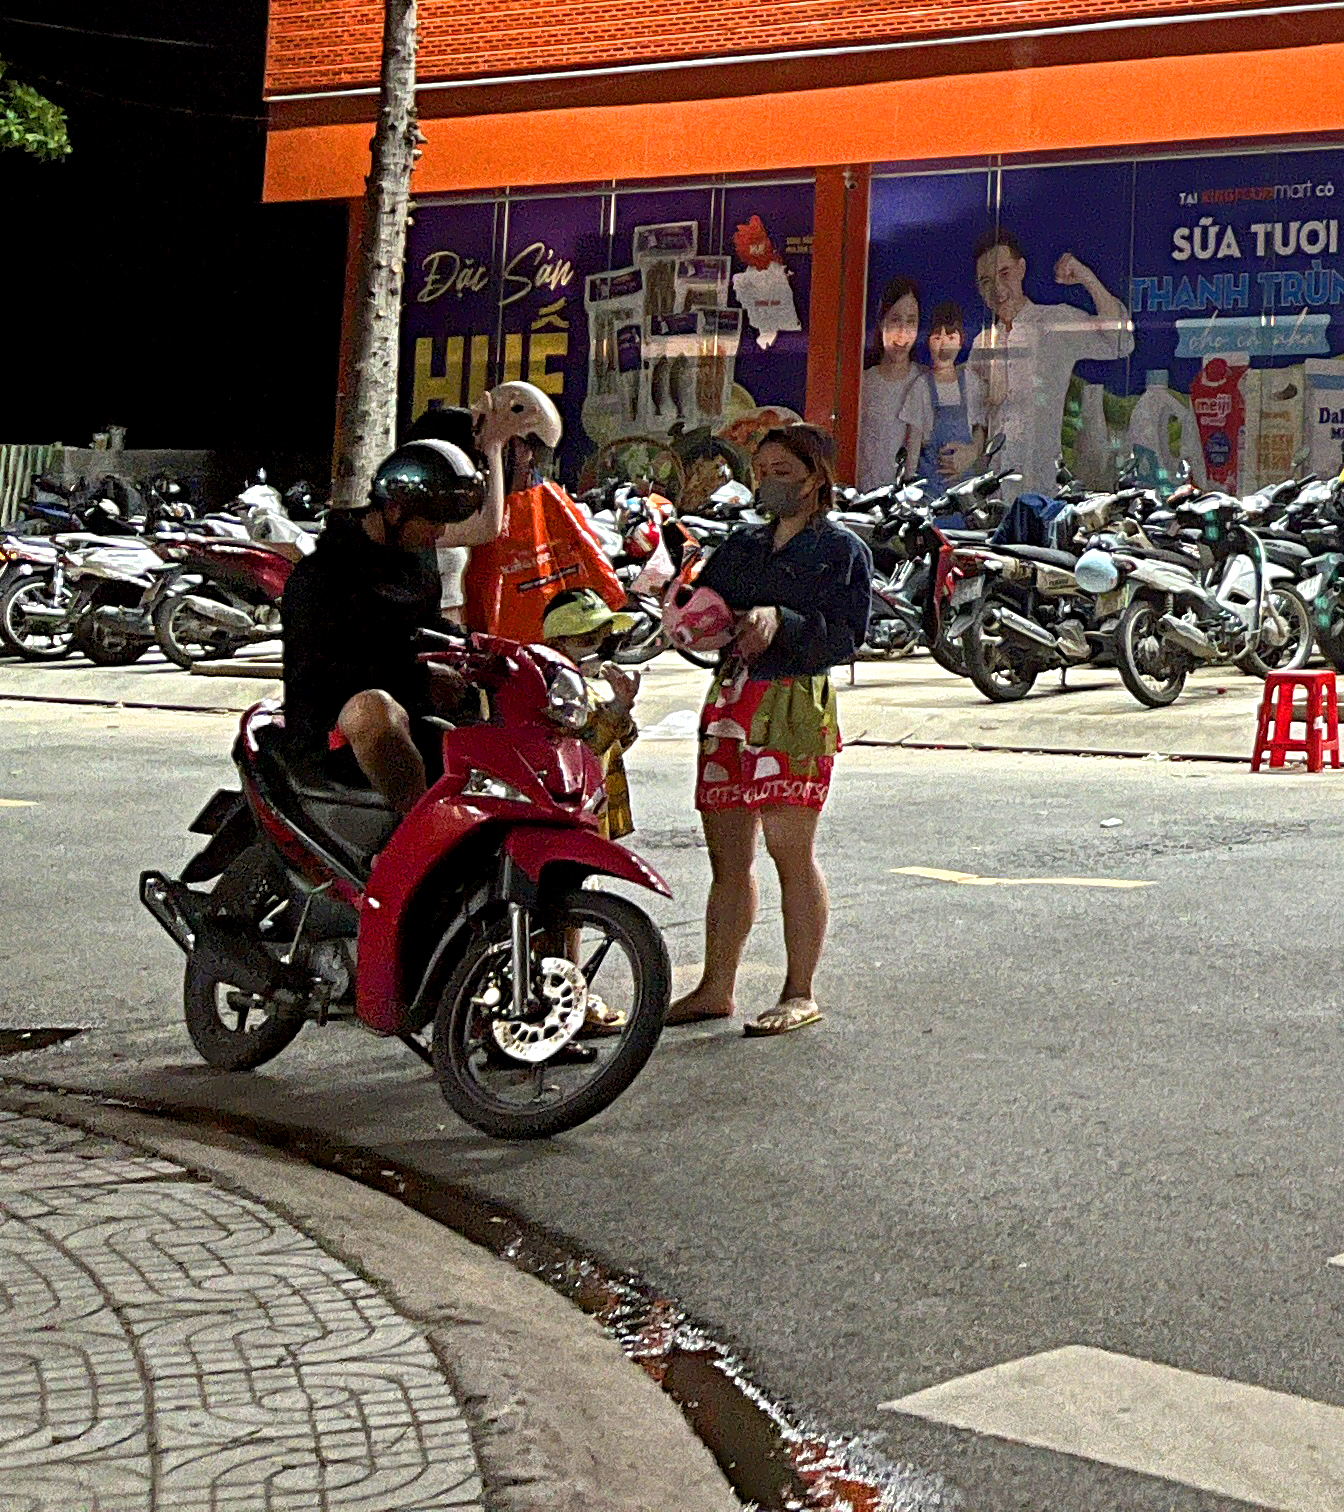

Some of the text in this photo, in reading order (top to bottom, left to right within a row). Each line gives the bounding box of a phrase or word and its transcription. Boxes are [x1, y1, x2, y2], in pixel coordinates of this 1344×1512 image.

[1171, 216, 1339, 261] SỮA TƯƠI
[1130, 272, 1250, 312] THANH
